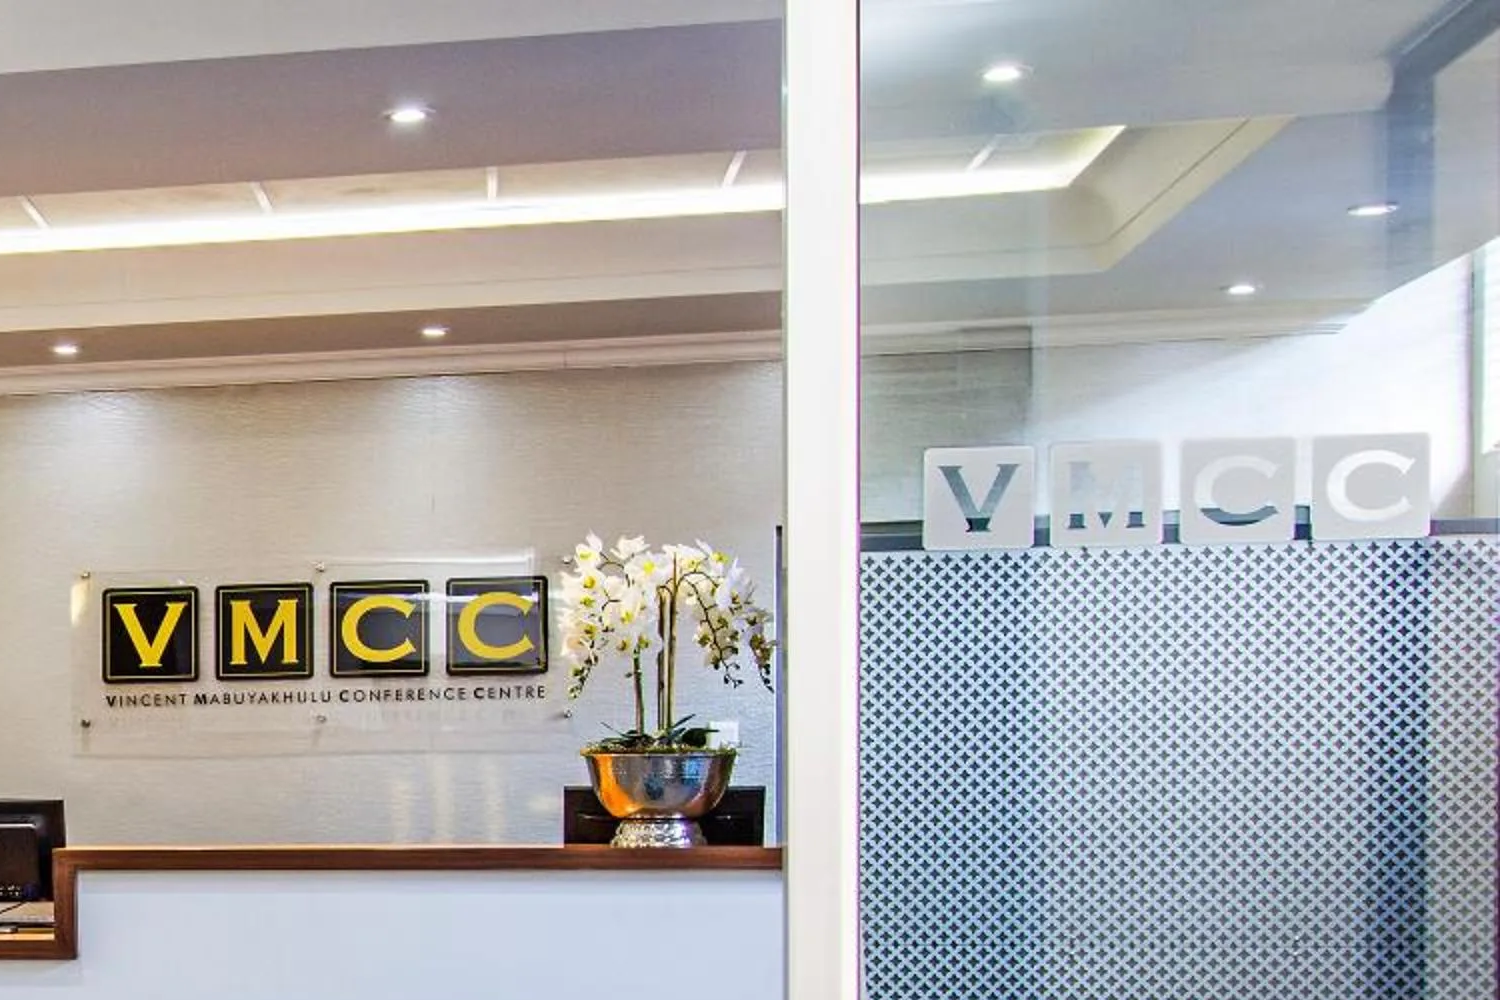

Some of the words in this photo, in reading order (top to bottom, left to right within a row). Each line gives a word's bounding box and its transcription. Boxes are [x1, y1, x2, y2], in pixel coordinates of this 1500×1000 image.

[113, 592, 535, 667] VMCC
[106, 693, 187, 708] VINCENT
[193, 690, 331, 705] MABUYAKHULU
[339, 688, 466, 703] CONFERENCE
[474, 685, 546, 700] CENTRE
